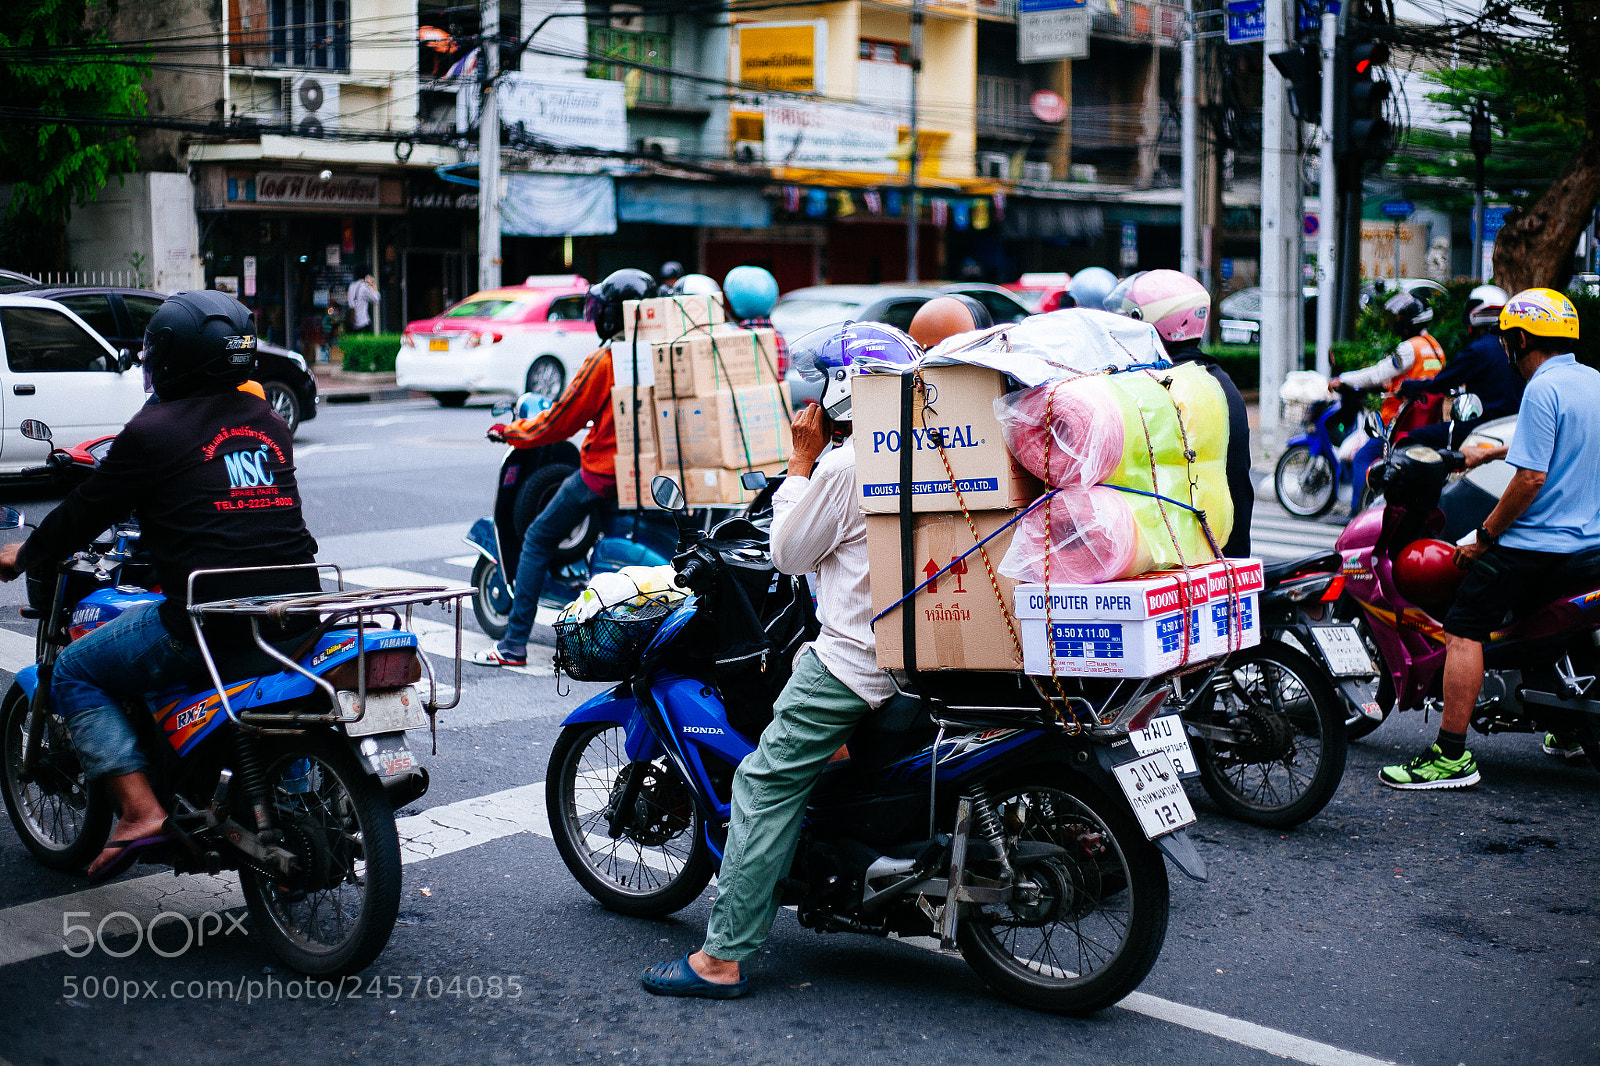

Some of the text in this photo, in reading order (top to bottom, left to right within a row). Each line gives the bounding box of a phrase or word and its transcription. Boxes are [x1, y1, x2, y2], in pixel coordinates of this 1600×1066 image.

[232, 354, 250, 363] INDEX
[872, 425, 979, 454] POYSEAL
[223, 449, 274, 488] MSC
[230, 487, 279, 498] SPARE PARTS
[870, 485, 893, 496] LOUIS
[895, 483, 932, 495] AESIVE
[933, 482, 956, 493] TAPE
[1096, 595, 1131, 610] PAPER
[1148, 583, 1207, 611] BOONYWAN
[924, 602, 971, 622] หมึกจีน
[1056, 628, 1076, 638] 9.50
[1077, 628, 1084, 638] X
[1085, 628, 1110, 638] 11.00
[379, 636, 412, 649] YAMAHA
[177, 699, 209, 731] RX-Z
[683, 726, 725, 735] HONDA
[1111, 738, 1129, 749] HONDA
[1154, 802, 1184, 828] 121
